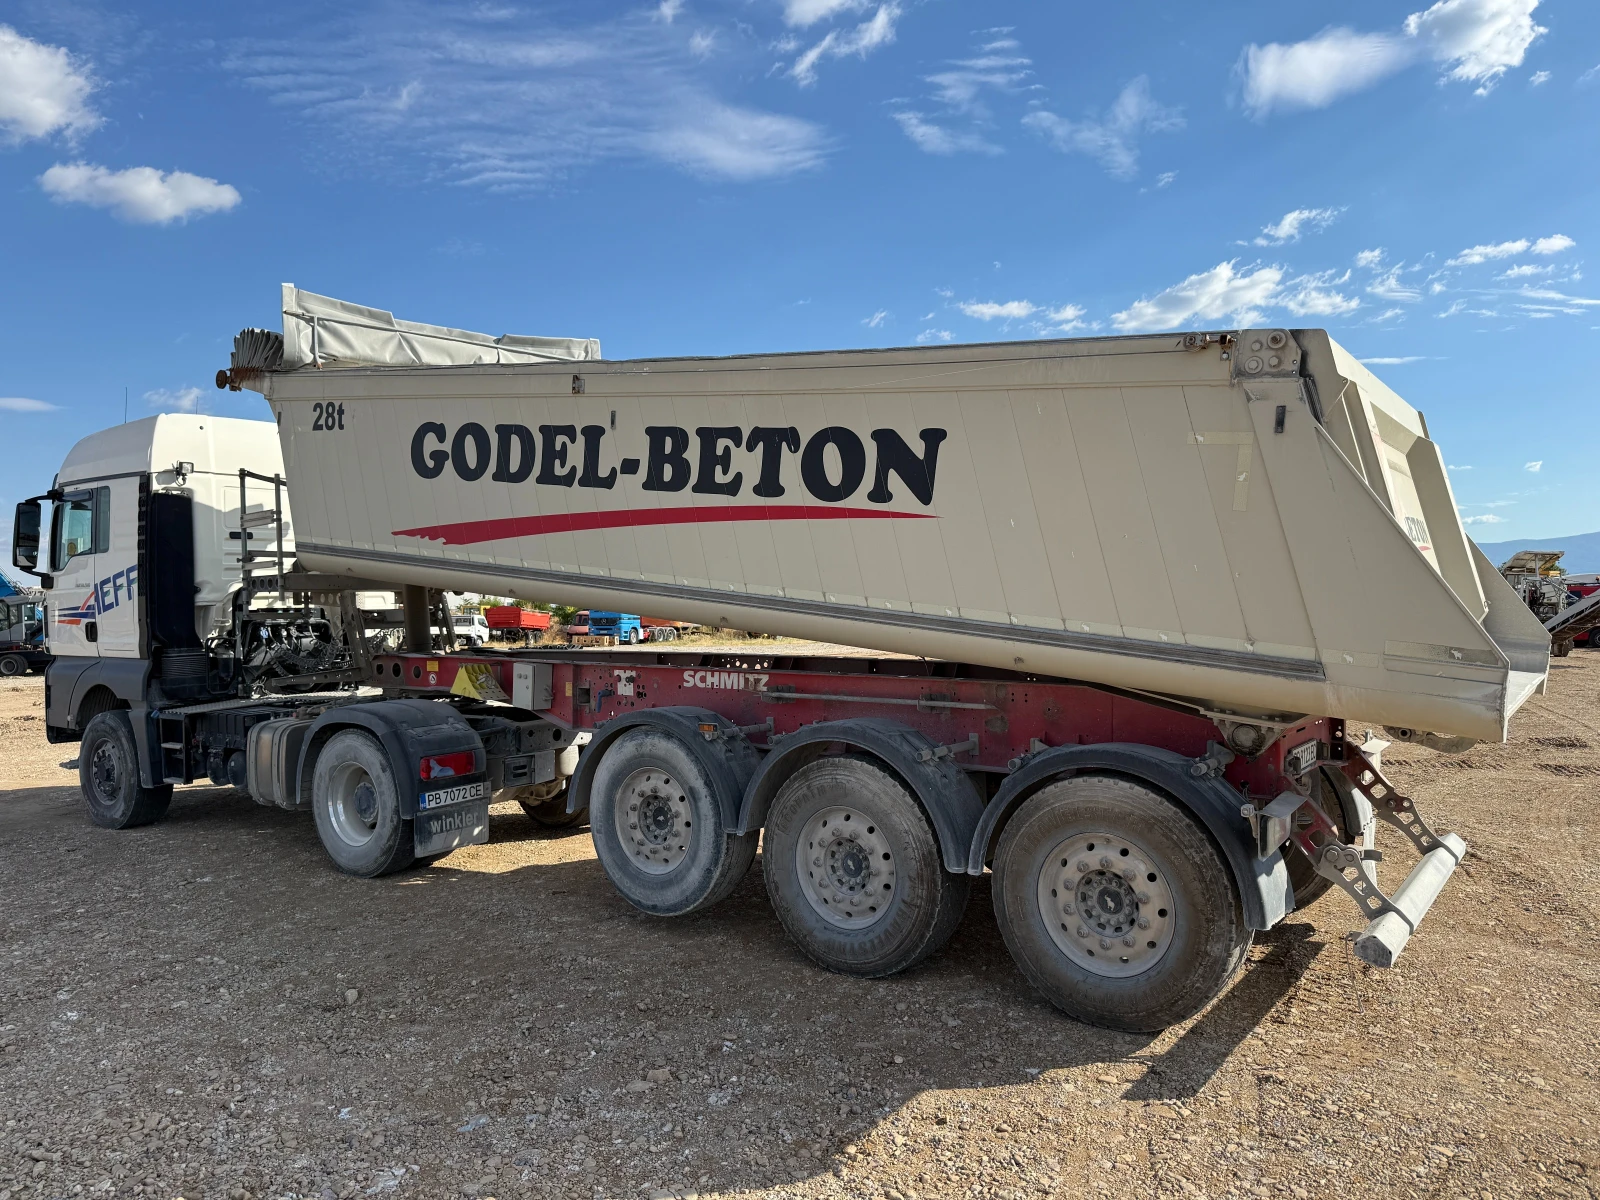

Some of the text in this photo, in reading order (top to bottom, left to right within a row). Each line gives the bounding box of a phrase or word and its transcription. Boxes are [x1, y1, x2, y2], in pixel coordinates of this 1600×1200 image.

[312, 401, 345, 431] 28t
[409, 421, 948, 506] GODEL-BETON
[683, 670, 769, 692] SCHMITZ
[427, 784, 482, 807] PB 7072 CE
[430, 811, 479, 834] winkler
